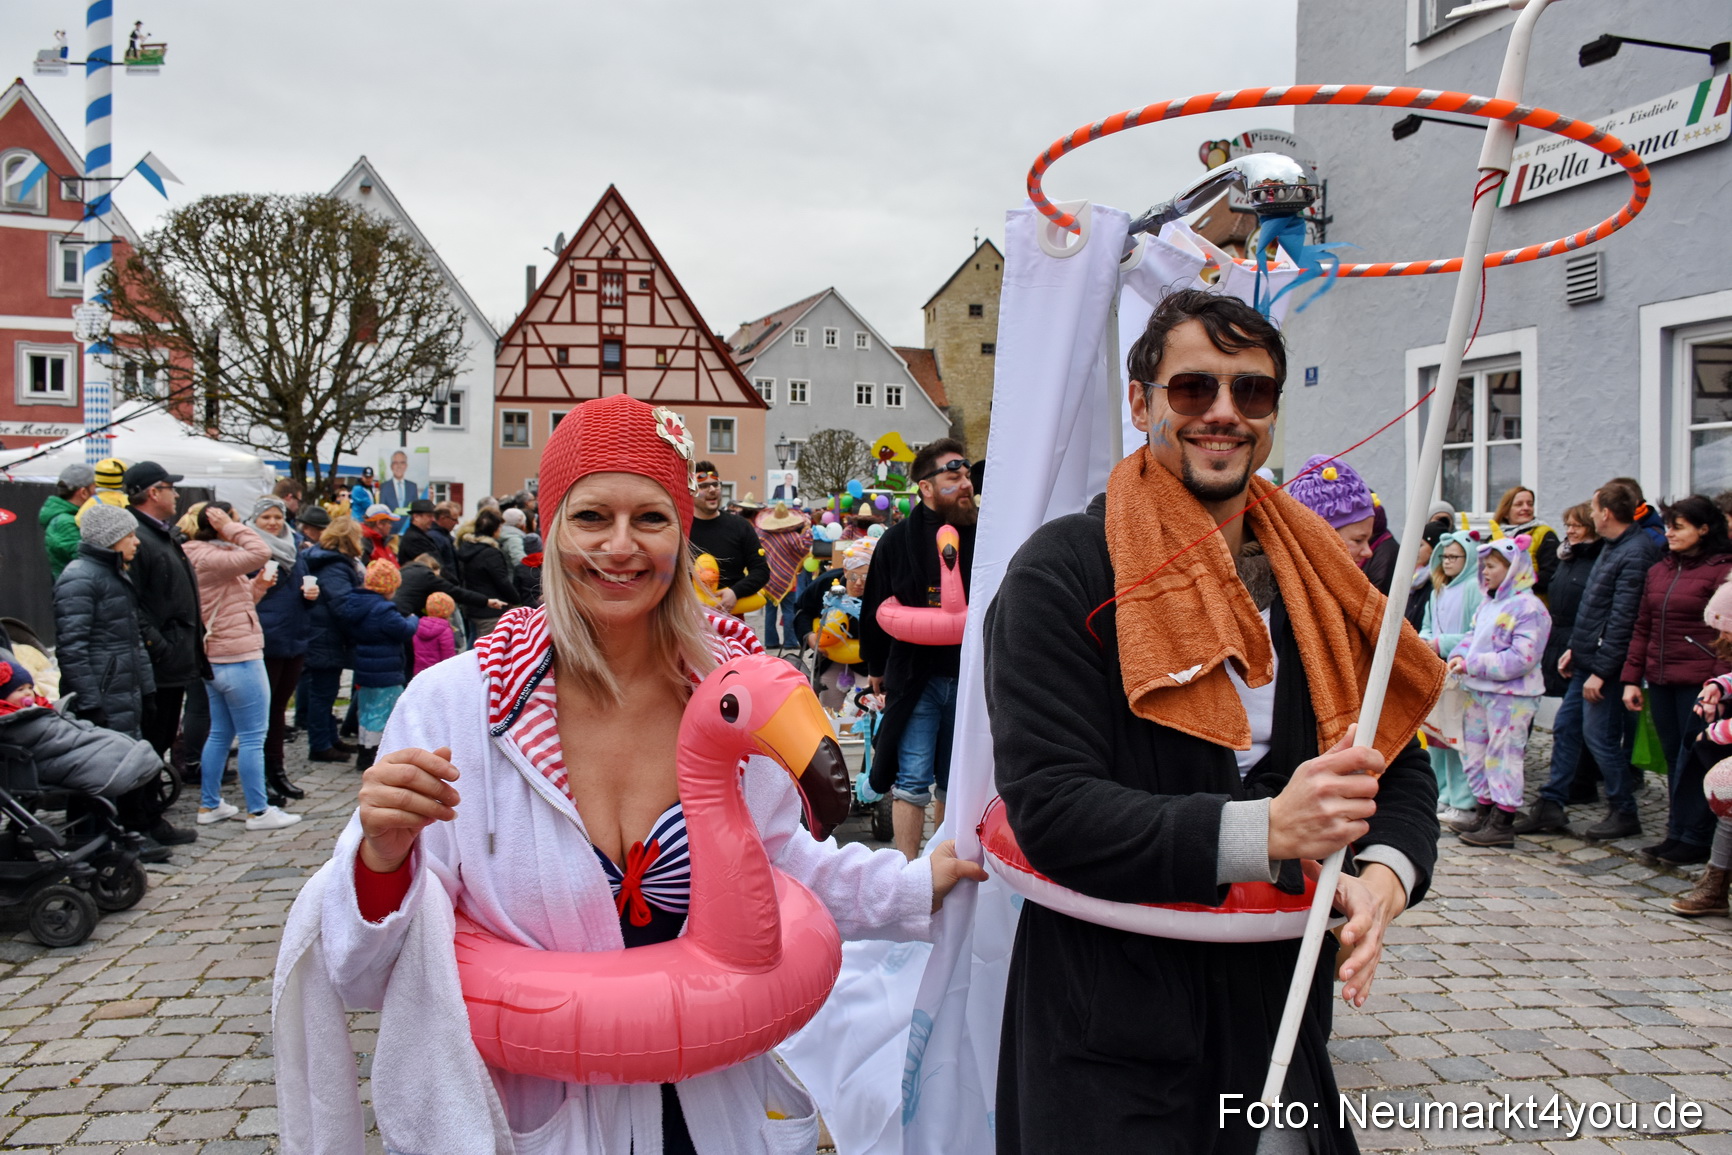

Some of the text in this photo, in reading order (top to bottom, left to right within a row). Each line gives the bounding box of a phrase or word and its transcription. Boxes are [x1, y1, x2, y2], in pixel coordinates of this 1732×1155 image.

[1628, 99, 1679, 125] Eisdiele
[1250, 131, 1297, 148] Pizzeria
[1526, 152, 1589, 191] Bella
[15, 424, 69, 436] Moden
